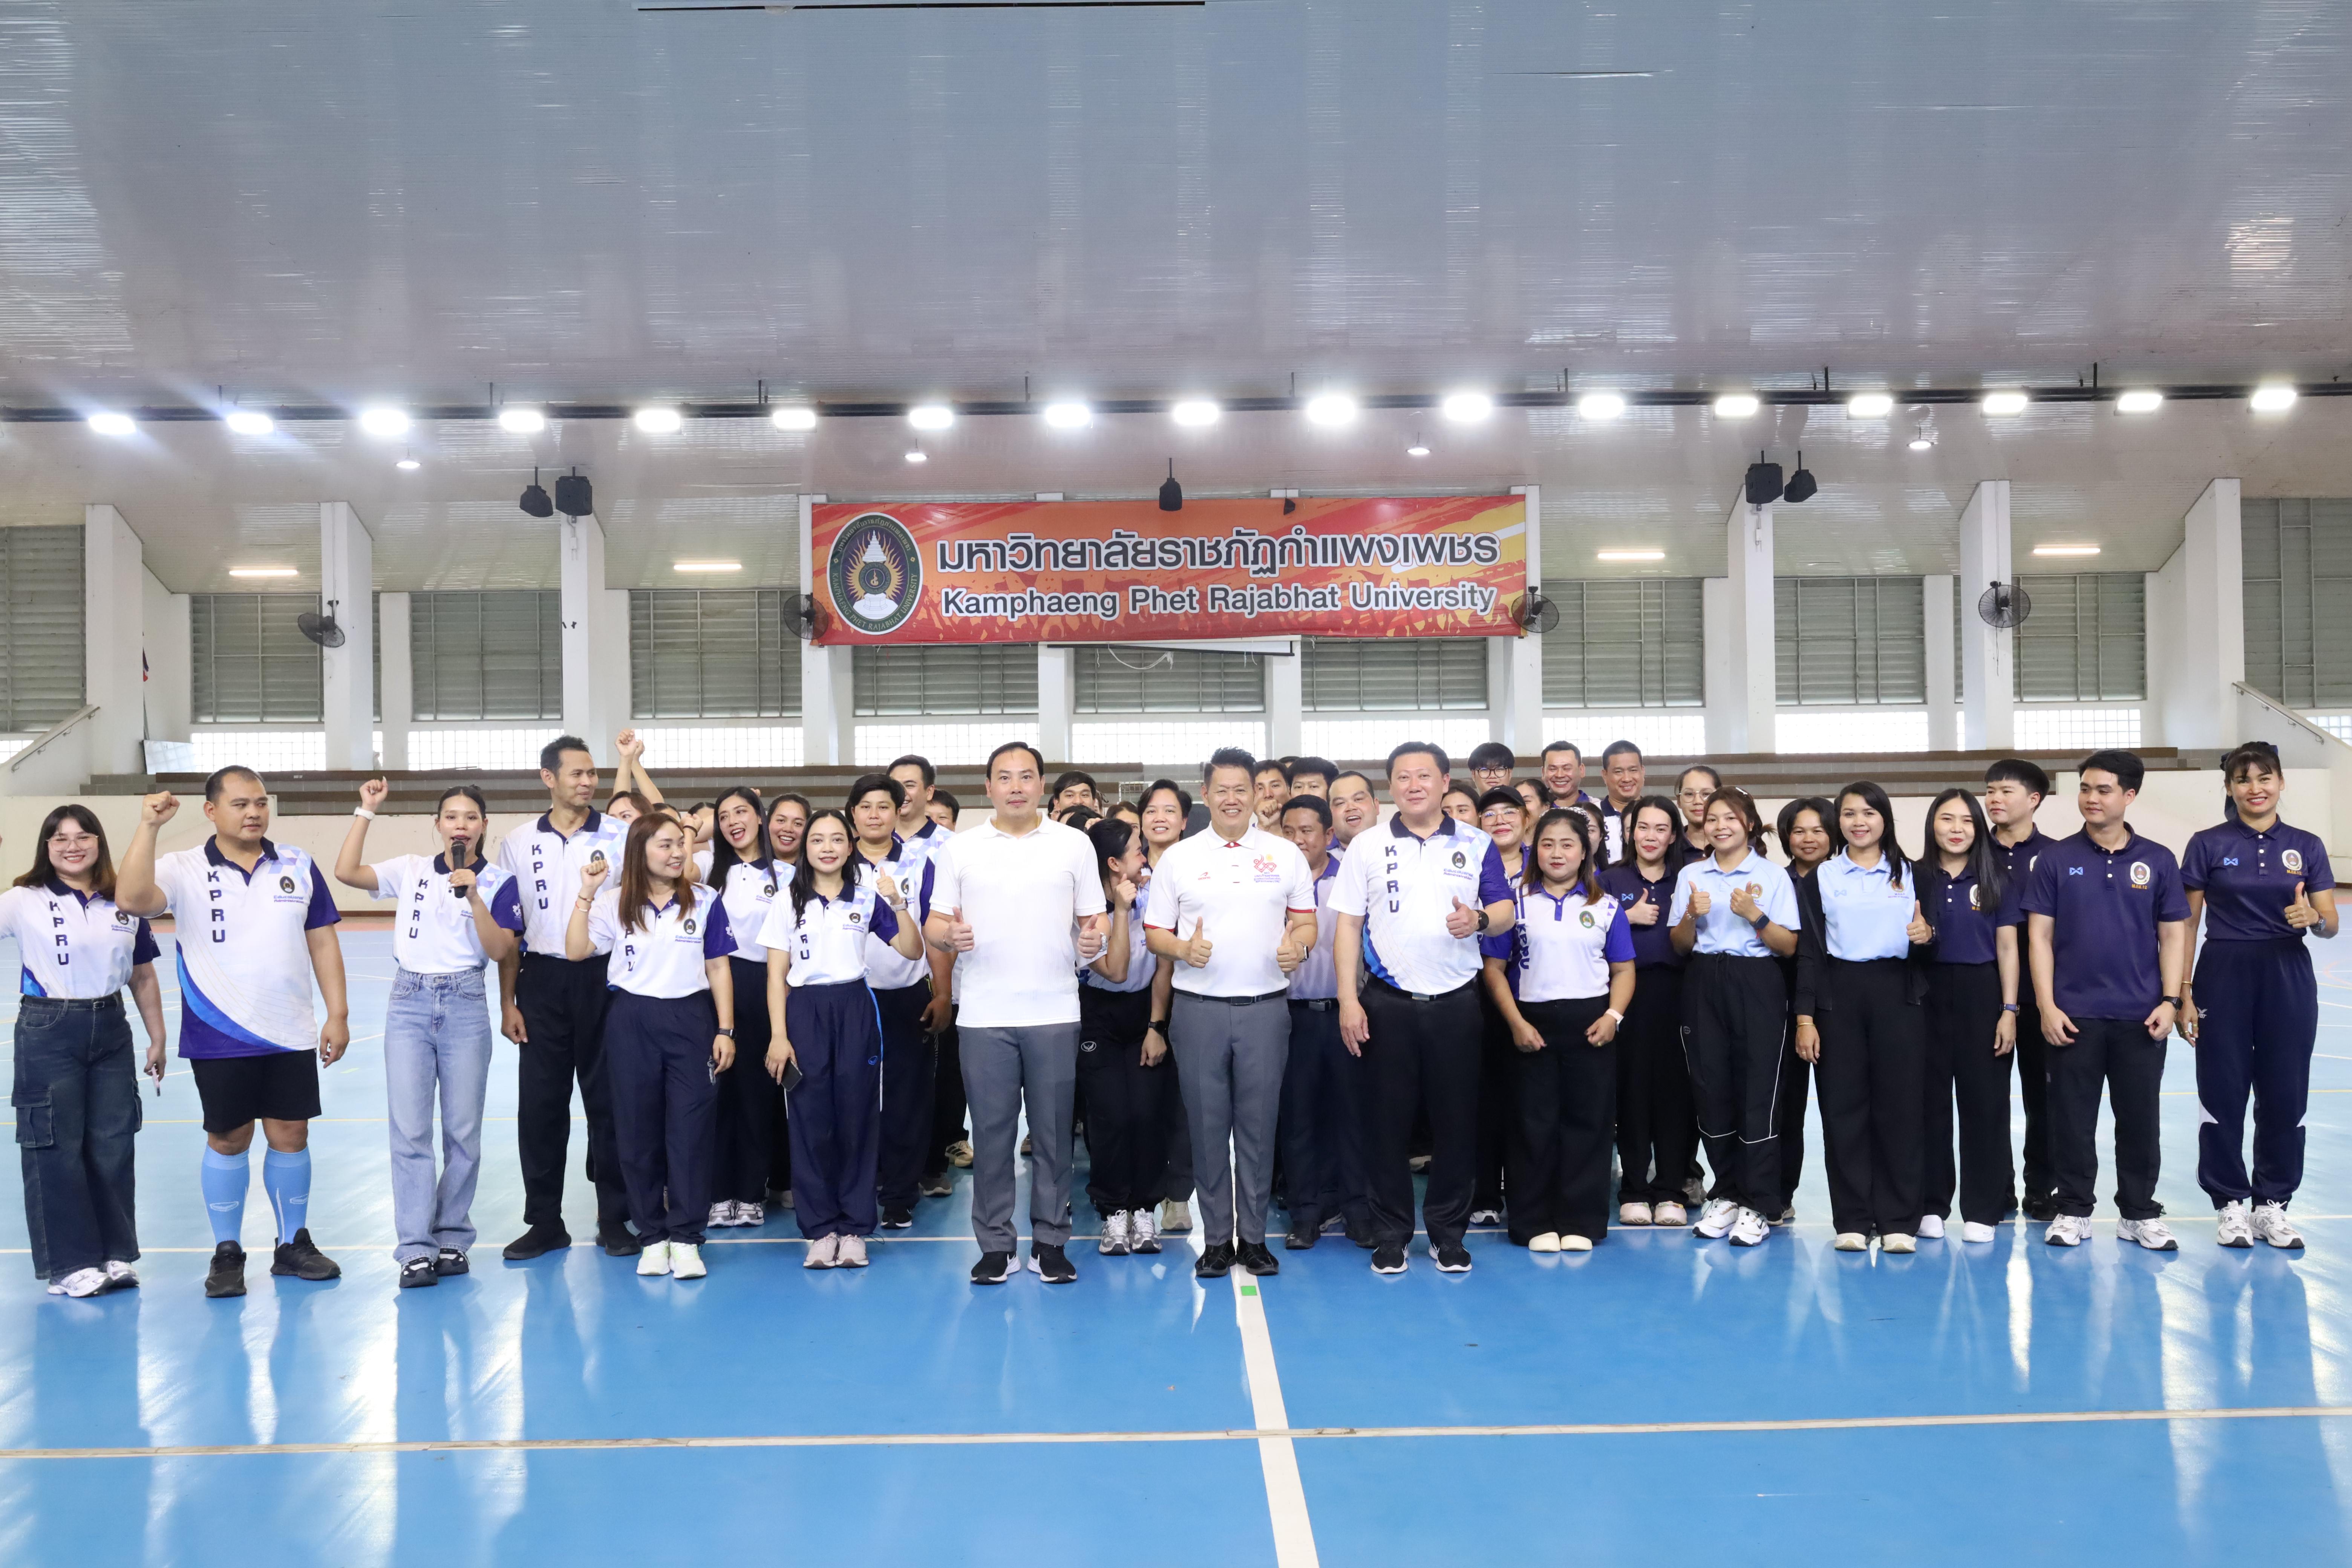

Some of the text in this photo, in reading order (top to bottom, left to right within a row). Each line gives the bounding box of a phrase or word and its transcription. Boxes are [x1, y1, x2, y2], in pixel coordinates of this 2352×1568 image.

[940, 528, 1498, 575] มหาวิทยาลัยราชภัฏกำแพงเพชร
[832, 573, 851, 616] KAMPHAENG
[850, 615, 867, 628] PHET
[868, 612, 902, 631] RAJABHAT
[900, 573, 917, 614] UNIVERSITY
[944, 585, 1494, 619] Kamphaeng Phet Rajabhat University
[208, 871, 225, 943] KPRU
[532, 844, 548, 910] KPRU
[1385, 845, 1399, 913] KPRU
[49, 901, 69, 965] KPRU
[409, 879, 429, 939] KPRU
